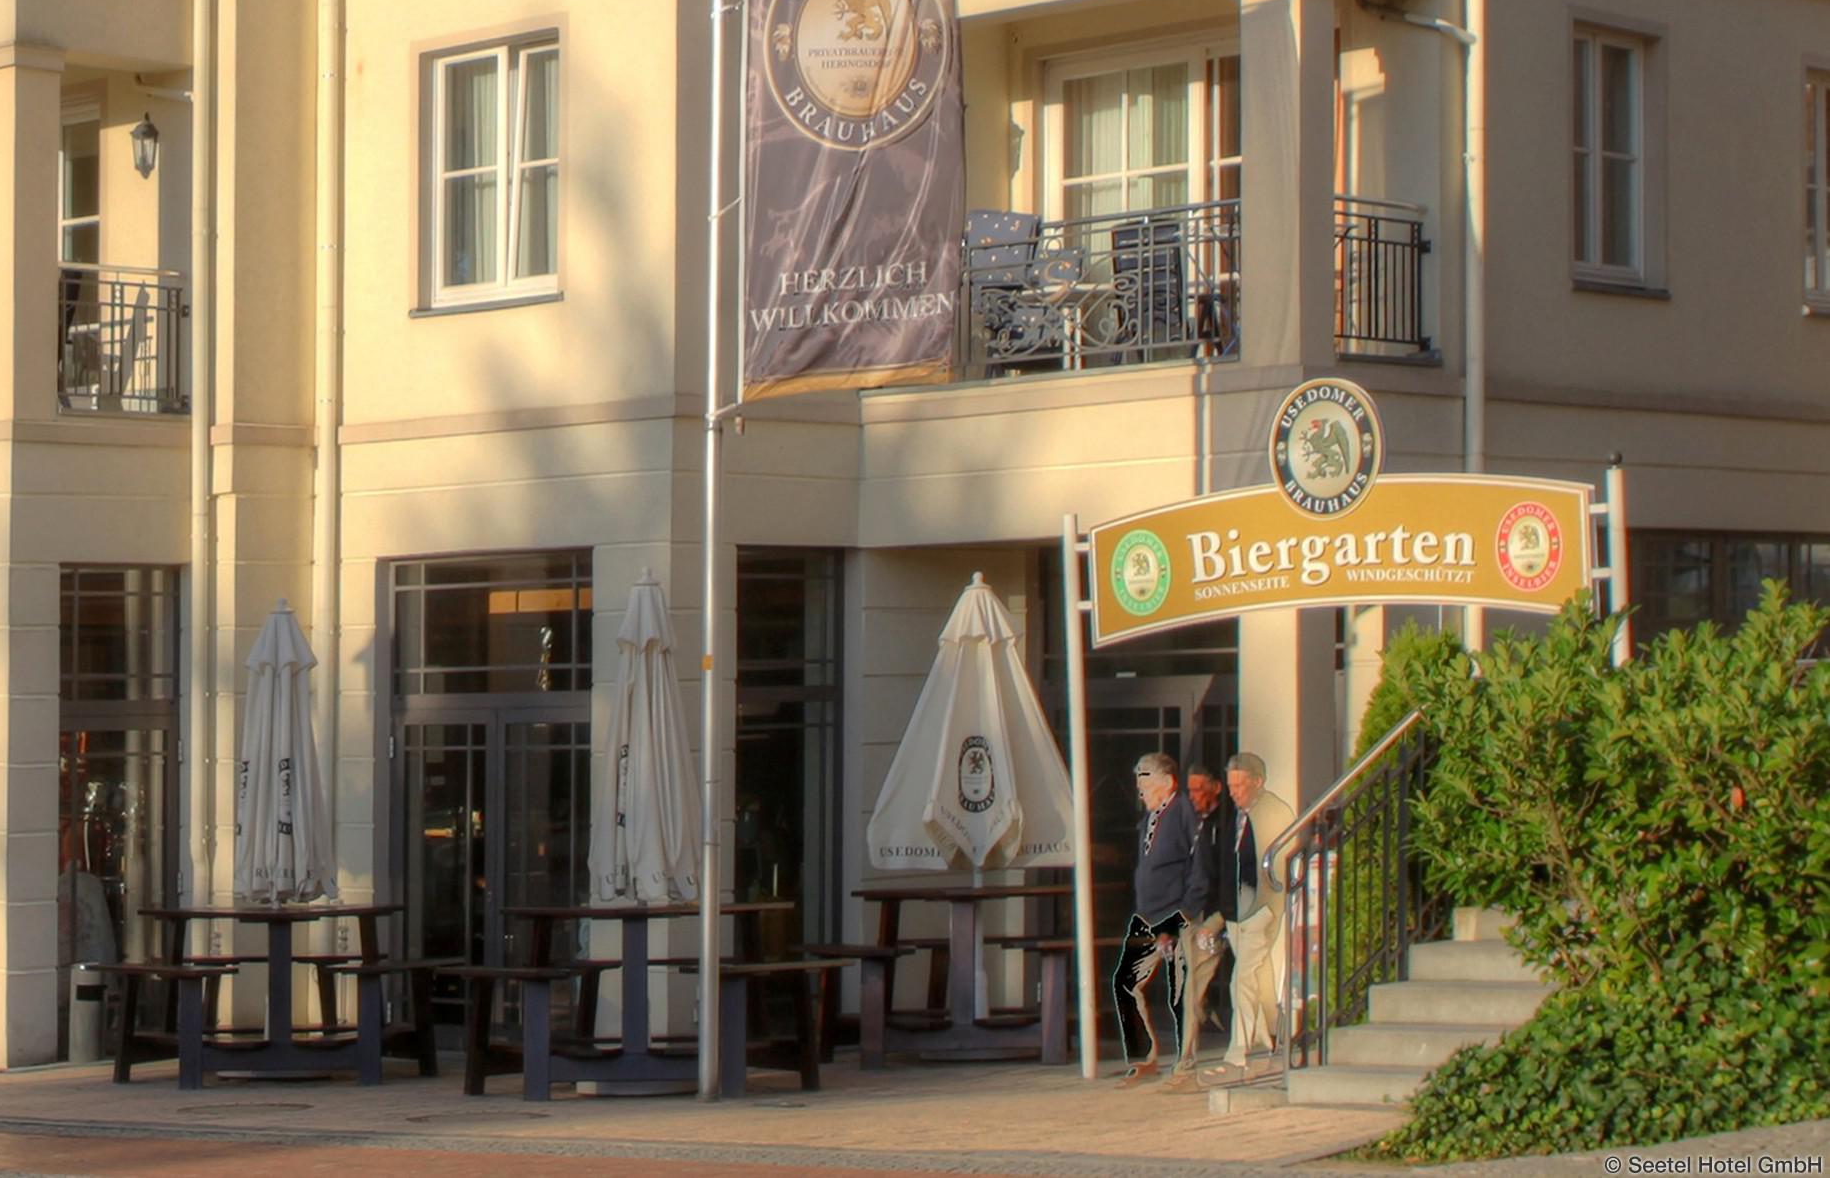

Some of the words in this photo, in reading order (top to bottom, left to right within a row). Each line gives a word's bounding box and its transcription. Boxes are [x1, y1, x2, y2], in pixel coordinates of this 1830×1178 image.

[785, 77, 928, 142] BRAUHAUS
[779, 261, 928, 296] HERZLICH
[749, 290, 956, 331] WILLKOMMEN
[1281, 386, 1365, 428] USEDOMER
[1285, 472, 1368, 513] BRAUHAUS
[1186, 524, 1477, 586] Biergarten
[1346, 567, 1476, 584] WINDGESCHÜTZT
[1194, 574, 1290, 601] SONNENSEITE
